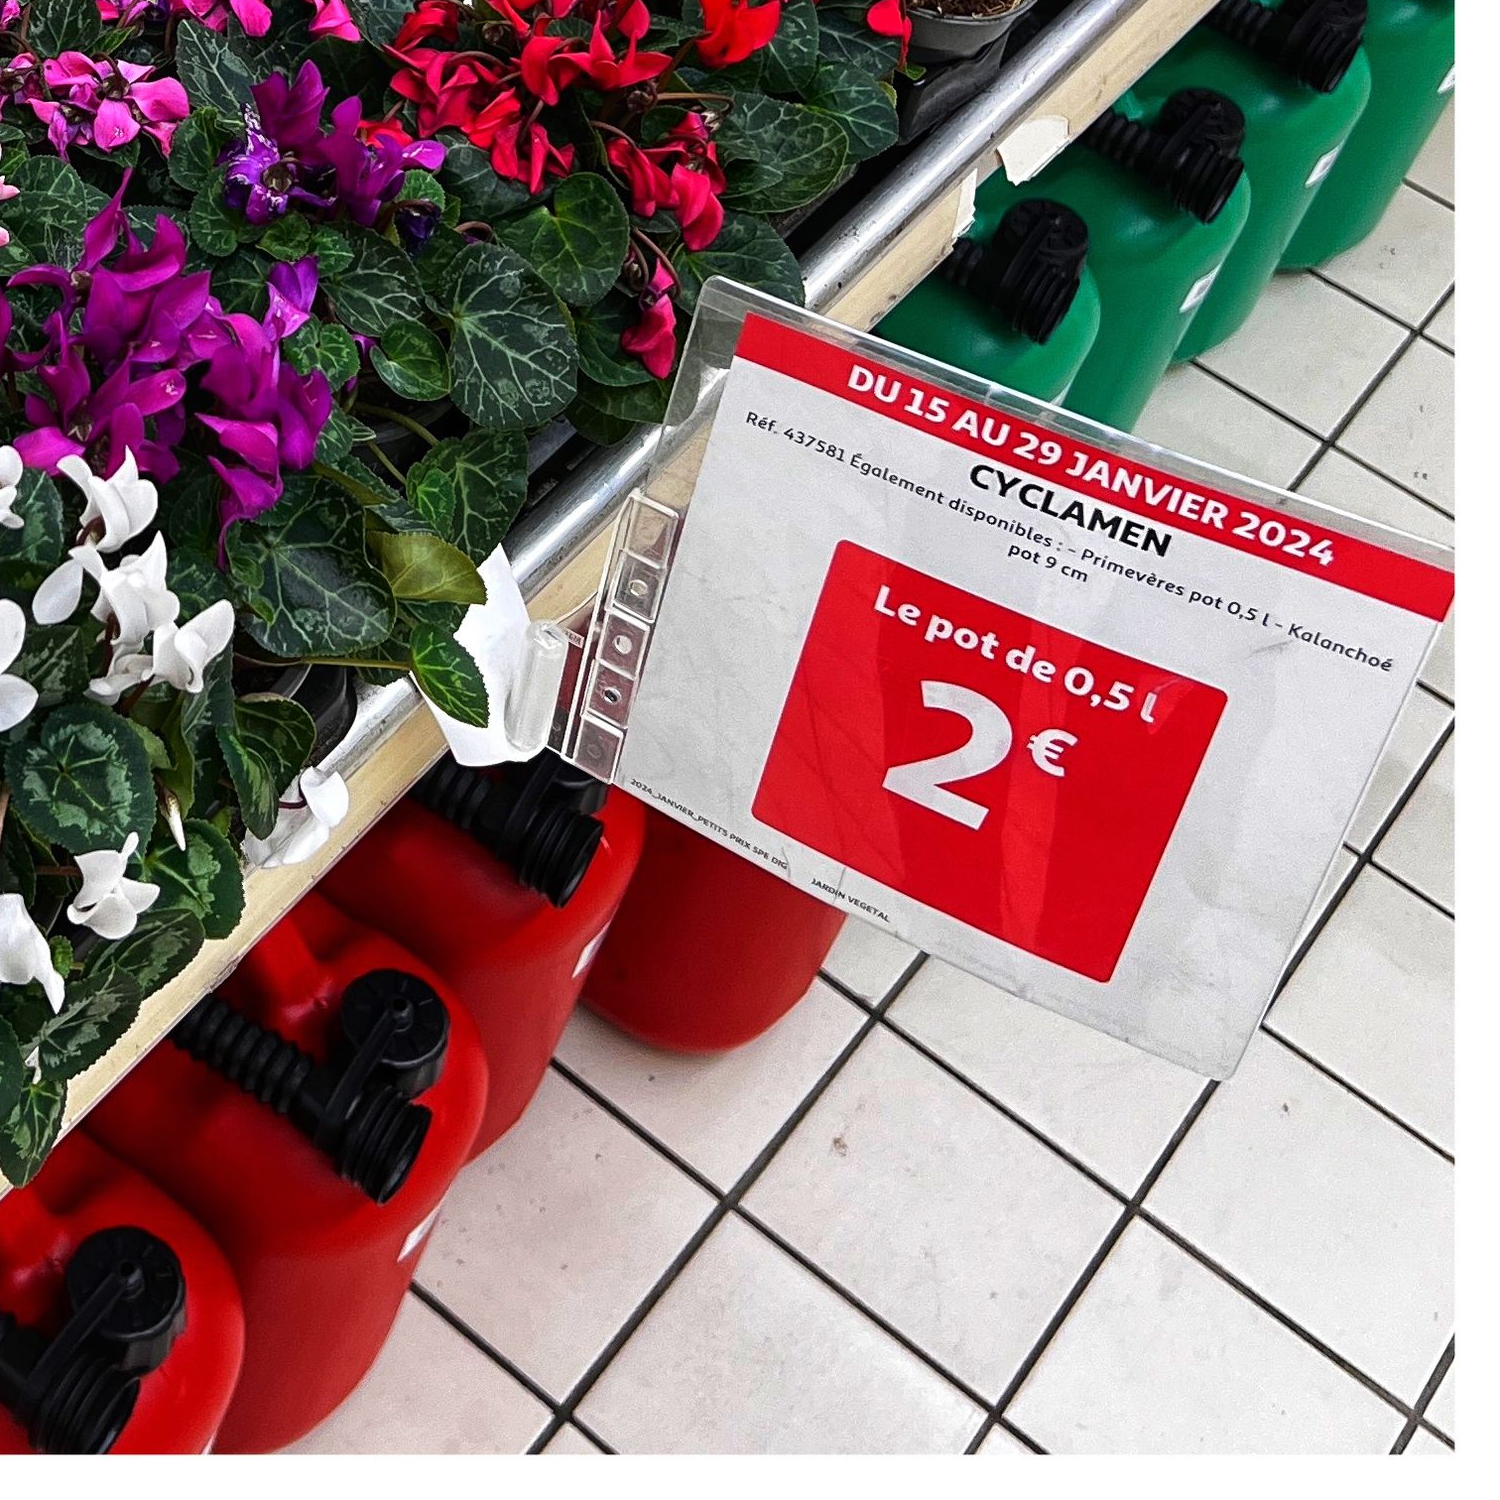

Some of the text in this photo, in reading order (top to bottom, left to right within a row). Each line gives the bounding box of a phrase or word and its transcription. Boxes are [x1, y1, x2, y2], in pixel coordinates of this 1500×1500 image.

[847, 364, 1335, 567] DU 15 AU 29 JANVIER 2024
[969, 464, 1173, 558] CYCLAMEN
[745, 411, 778, 435] Réf.
[783, 426, 845, 463] 437581
[849, 453, 945, 505] Également
[949, 498, 1053, 548] disponibles
[1080, 548, 1185, 596] Primevères
[1188, 589, 1224, 611] pot
[1227, 601, 1259, 621] 0,5
[1287, 623, 1393, 673] Kalanchoé
[1007, 544, 1089, 583] pot 9 cm
[873, 584, 922, 627] Le
[924, 614, 1000, 660] pot
[1004, 645, 1057, 684] de
[1063, 666, 1136, 712] 0,5
[881, 679, 1079, 832] 2 €
[729, 833, 752, 851] PRIX
[811, 876, 891, 923] JARDIN VEGETAL
